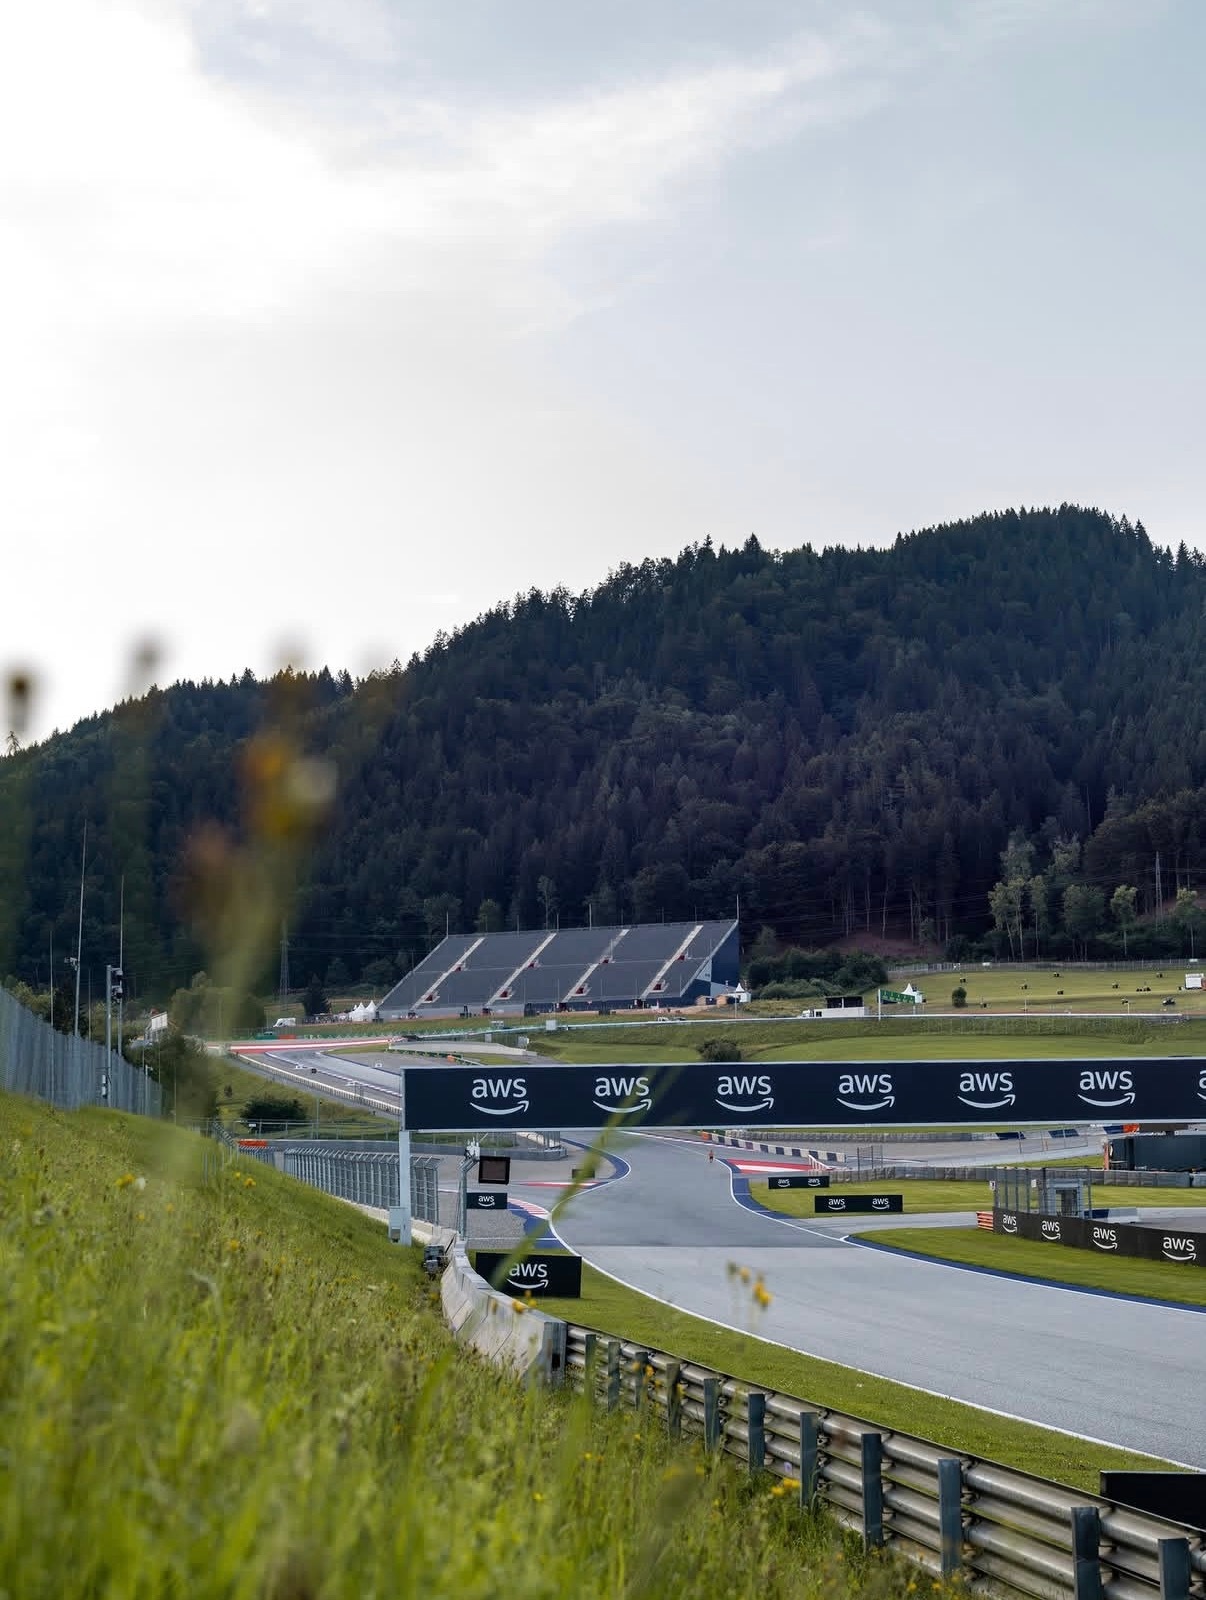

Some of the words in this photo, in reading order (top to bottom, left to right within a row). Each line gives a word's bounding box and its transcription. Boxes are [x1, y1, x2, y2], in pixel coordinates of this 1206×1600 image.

[471, 1078, 527, 1099] aws
[594, 1076, 650, 1097] aws
[717, 1075, 772, 1096] aws
[838, 1074, 893, 1094] aws
[959, 1072, 1013, 1092] aws
[1079, 1070, 1133, 1091] aws
[478, 1195, 495, 1203] aws
[872, 1197, 889, 1205] aws
[1002, 1214, 1017, 1226] aws
[1041, 1220, 1060, 1233] aws
[1093, 1227, 1117, 1242] aws
[1162, 1237, 1195, 1252] aws
[508, 1262, 548, 1278] aws
